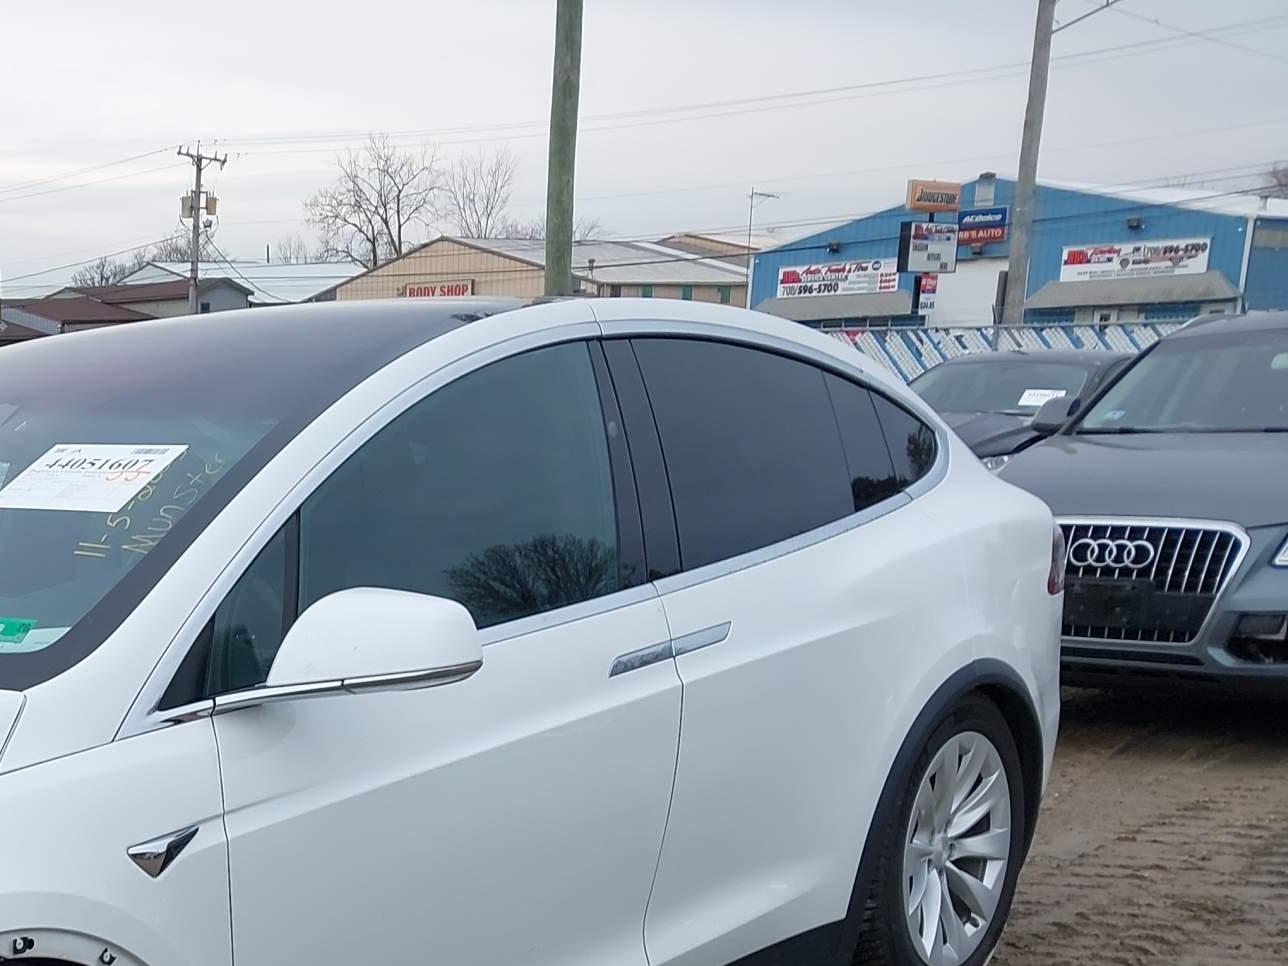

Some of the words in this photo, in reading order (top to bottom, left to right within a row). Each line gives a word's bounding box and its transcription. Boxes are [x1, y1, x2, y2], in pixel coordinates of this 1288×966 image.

[978, 228, 1002, 239] AUTO
[408, 286, 436, 297] BODY
[439, 284, 469, 296] SHOP
[44, 457, 155, 470] 44051607
